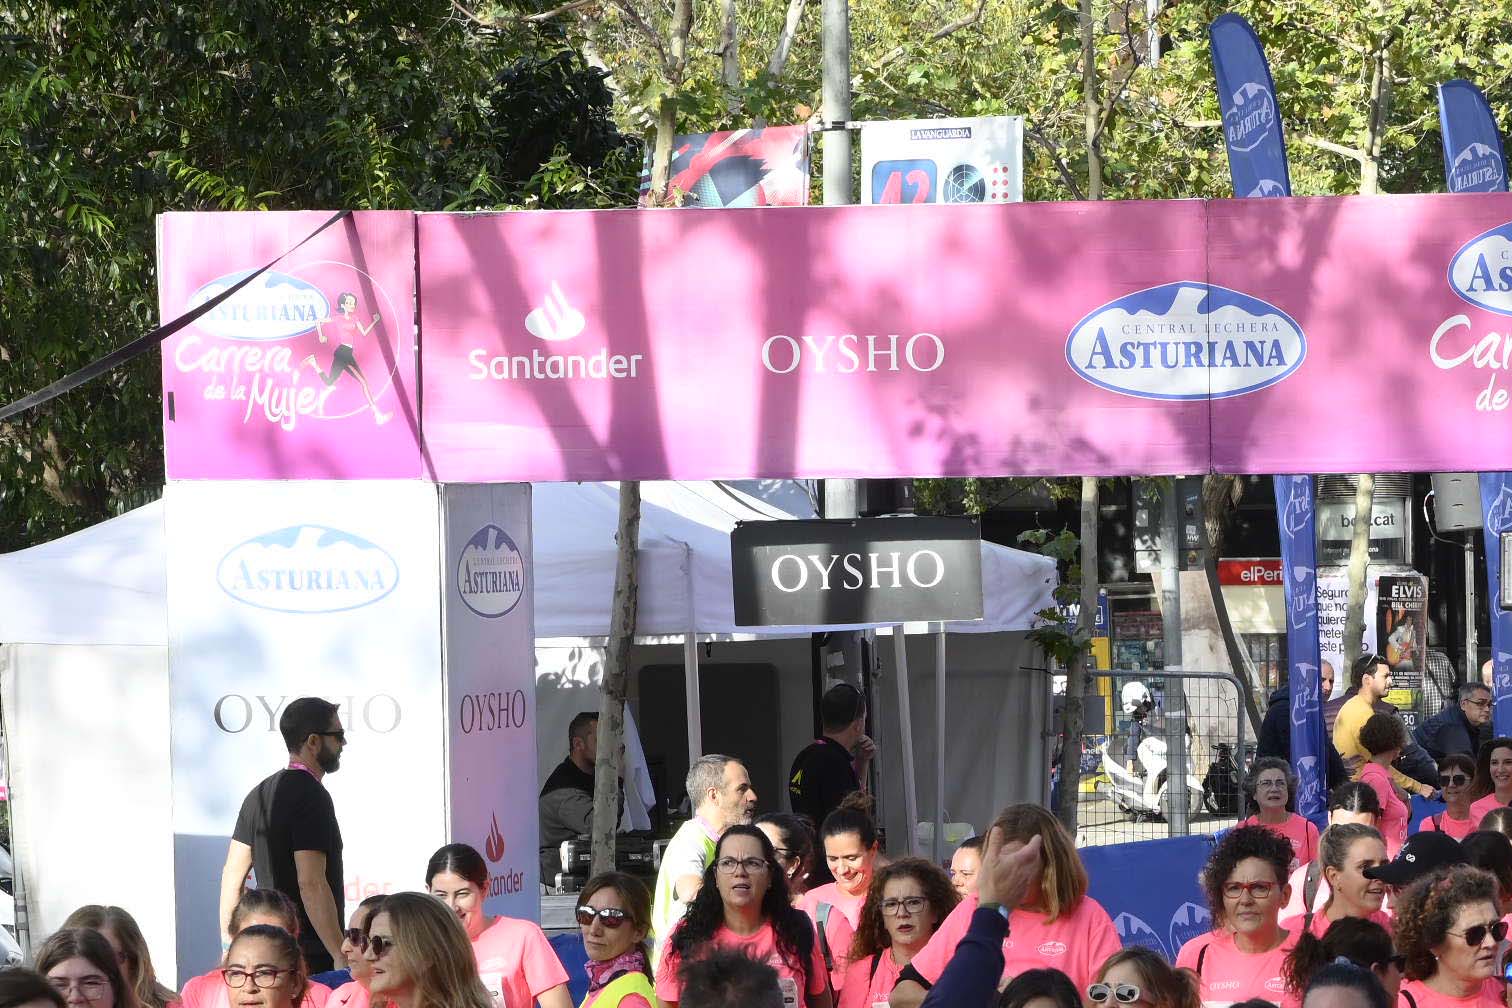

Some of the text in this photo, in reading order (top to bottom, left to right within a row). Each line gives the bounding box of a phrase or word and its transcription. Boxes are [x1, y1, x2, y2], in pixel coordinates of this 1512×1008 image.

[1121, 321, 1279, 335] CENTRAL LECHERA
[175, 335, 292, 373] Carrera
[468, 347, 643, 381] Santander
[761, 333, 945, 373] OYSHO
[1084, 327, 1288, 370] ASTURIANA
[244, 371, 337, 431] Mujer
[1475, 373, 1508, 412] de
[232, 559, 387, 591] ASTURIANA
[462, 559, 521, 595] ASTURIANA
[771, 551, 945, 592] OYSHO
[1392, 585, 1423, 598] ELVIS
[213, 694, 402, 734] OYHO
[460, 689, 526, 734] OYSHO
